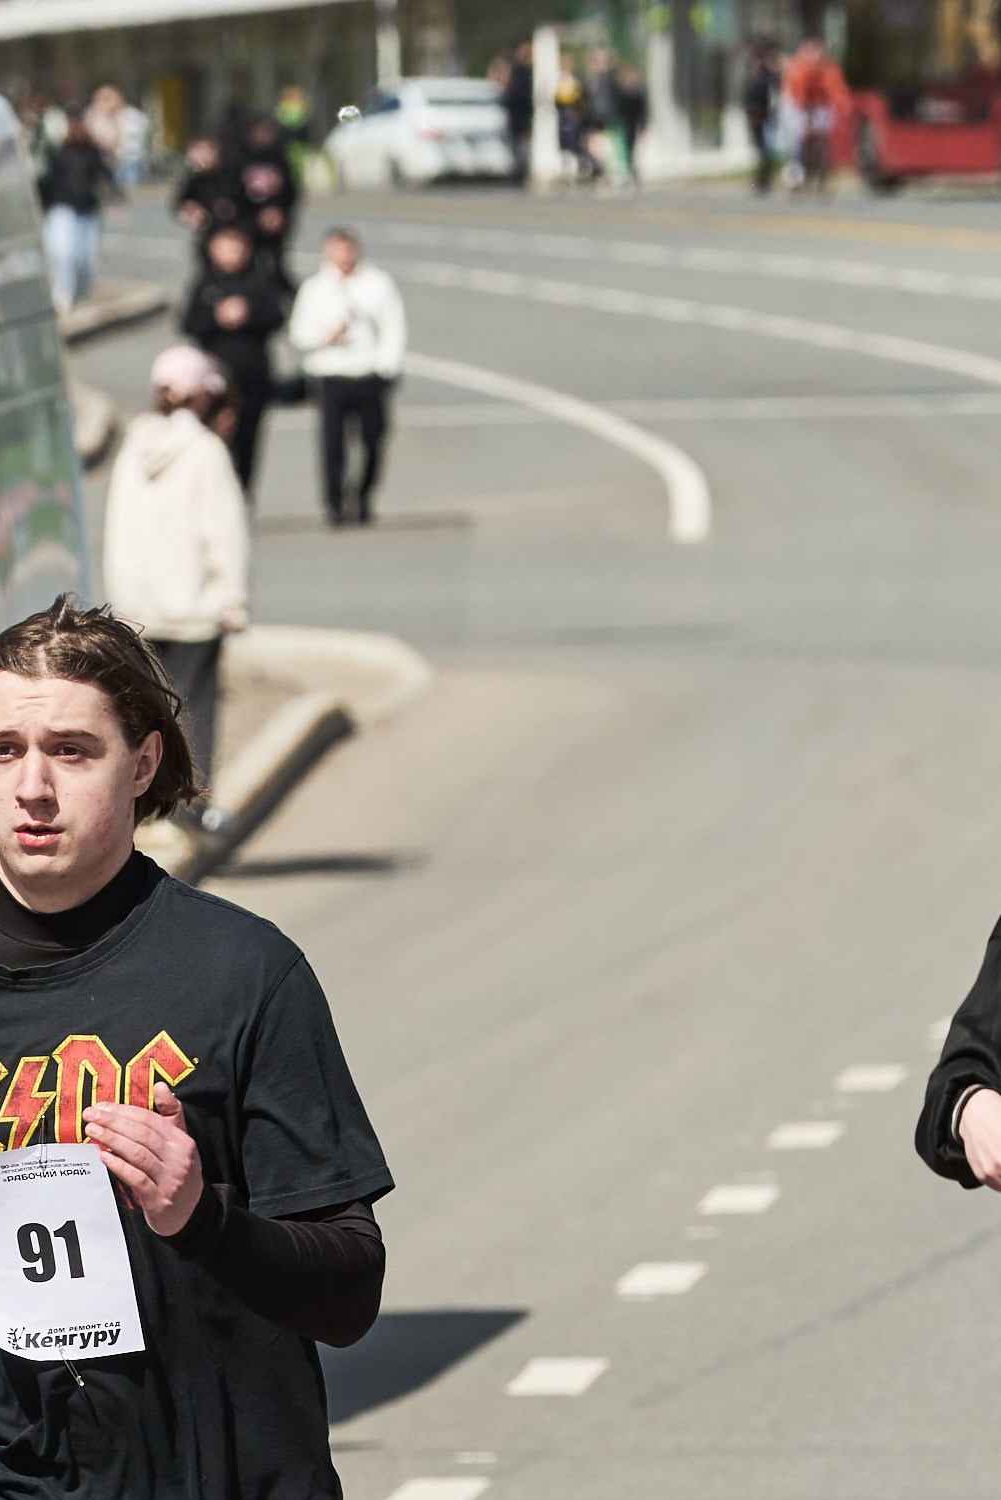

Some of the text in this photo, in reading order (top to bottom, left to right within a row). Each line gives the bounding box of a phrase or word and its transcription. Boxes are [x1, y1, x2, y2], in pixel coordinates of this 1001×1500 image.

[2, 1167, 91, 1182] «РАБОЧИЙ КРАЙ»
[17, 1220, 85, 1283] 91
[47, 1327, 65, 1335] ДОМ
[69, 1323, 101, 1332] РЕМОНТ
[25, 1328, 121, 1350] Кенгуру
